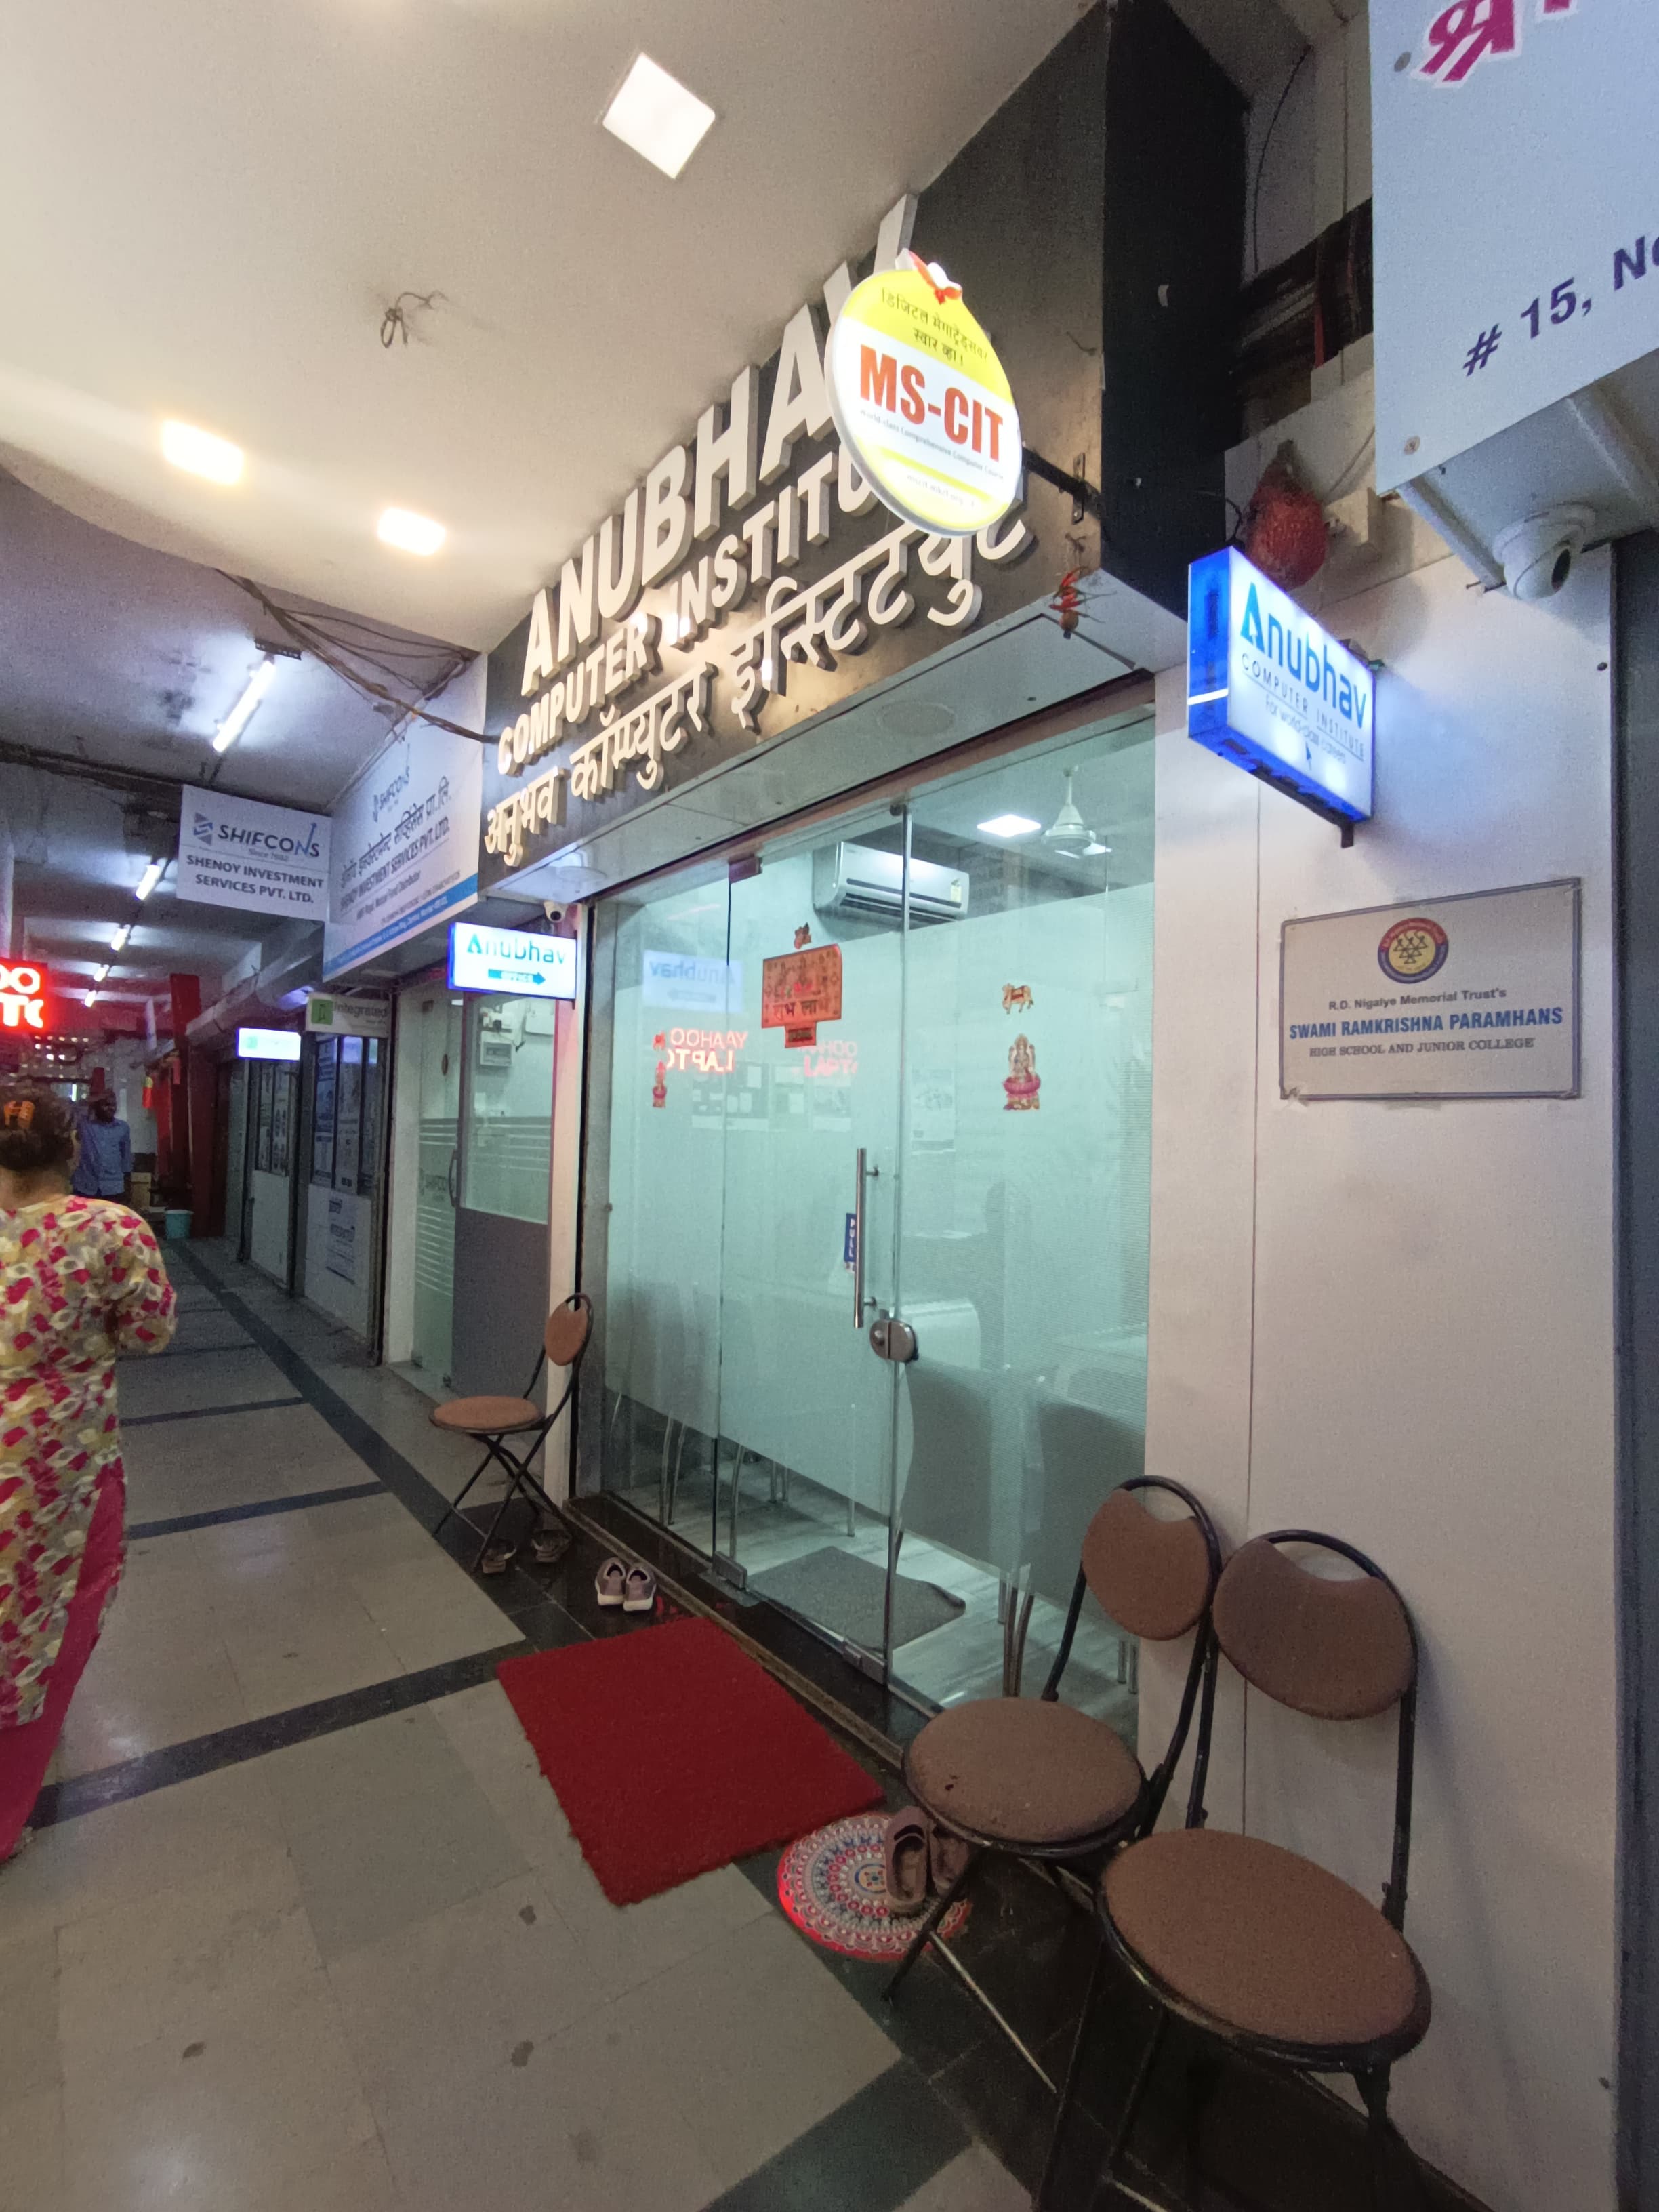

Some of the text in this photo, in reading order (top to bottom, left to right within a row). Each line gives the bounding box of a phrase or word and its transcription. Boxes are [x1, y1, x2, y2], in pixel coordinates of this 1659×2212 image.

[1462, 323, 1502, 377] #
[1520, 276, 1592, 339] 15,
[860, 344, 1004, 462] MS-CIT
[498, 442, 876, 775] COMPUTER INSTITU
[1240, 581, 1368, 729] Anubhav
[1242, 653, 1364, 758] COMPUTER INSTITUTE
[484, 766, 559, 867] अनुभव
[218, 822, 321, 857] SHIFCONS
[186, 855, 241, 874] SHENOY
[243, 866, 325, 888] INVESTMENT
[195, 874, 314, 903] SERVICES PVT. LTD.
[466, 933, 567, 965] Anubhav
[1400, 991, 1457, 1005] Memorial
[1461, 987, 1507, 1000] Trust's
[1290, 1007, 1563, 1039] SWAMI RAMKRISHNA PARAMHANS
[1309, 1037, 1536, 1057] HIGH SCHOOL AND JUNIOR COLLEGE
